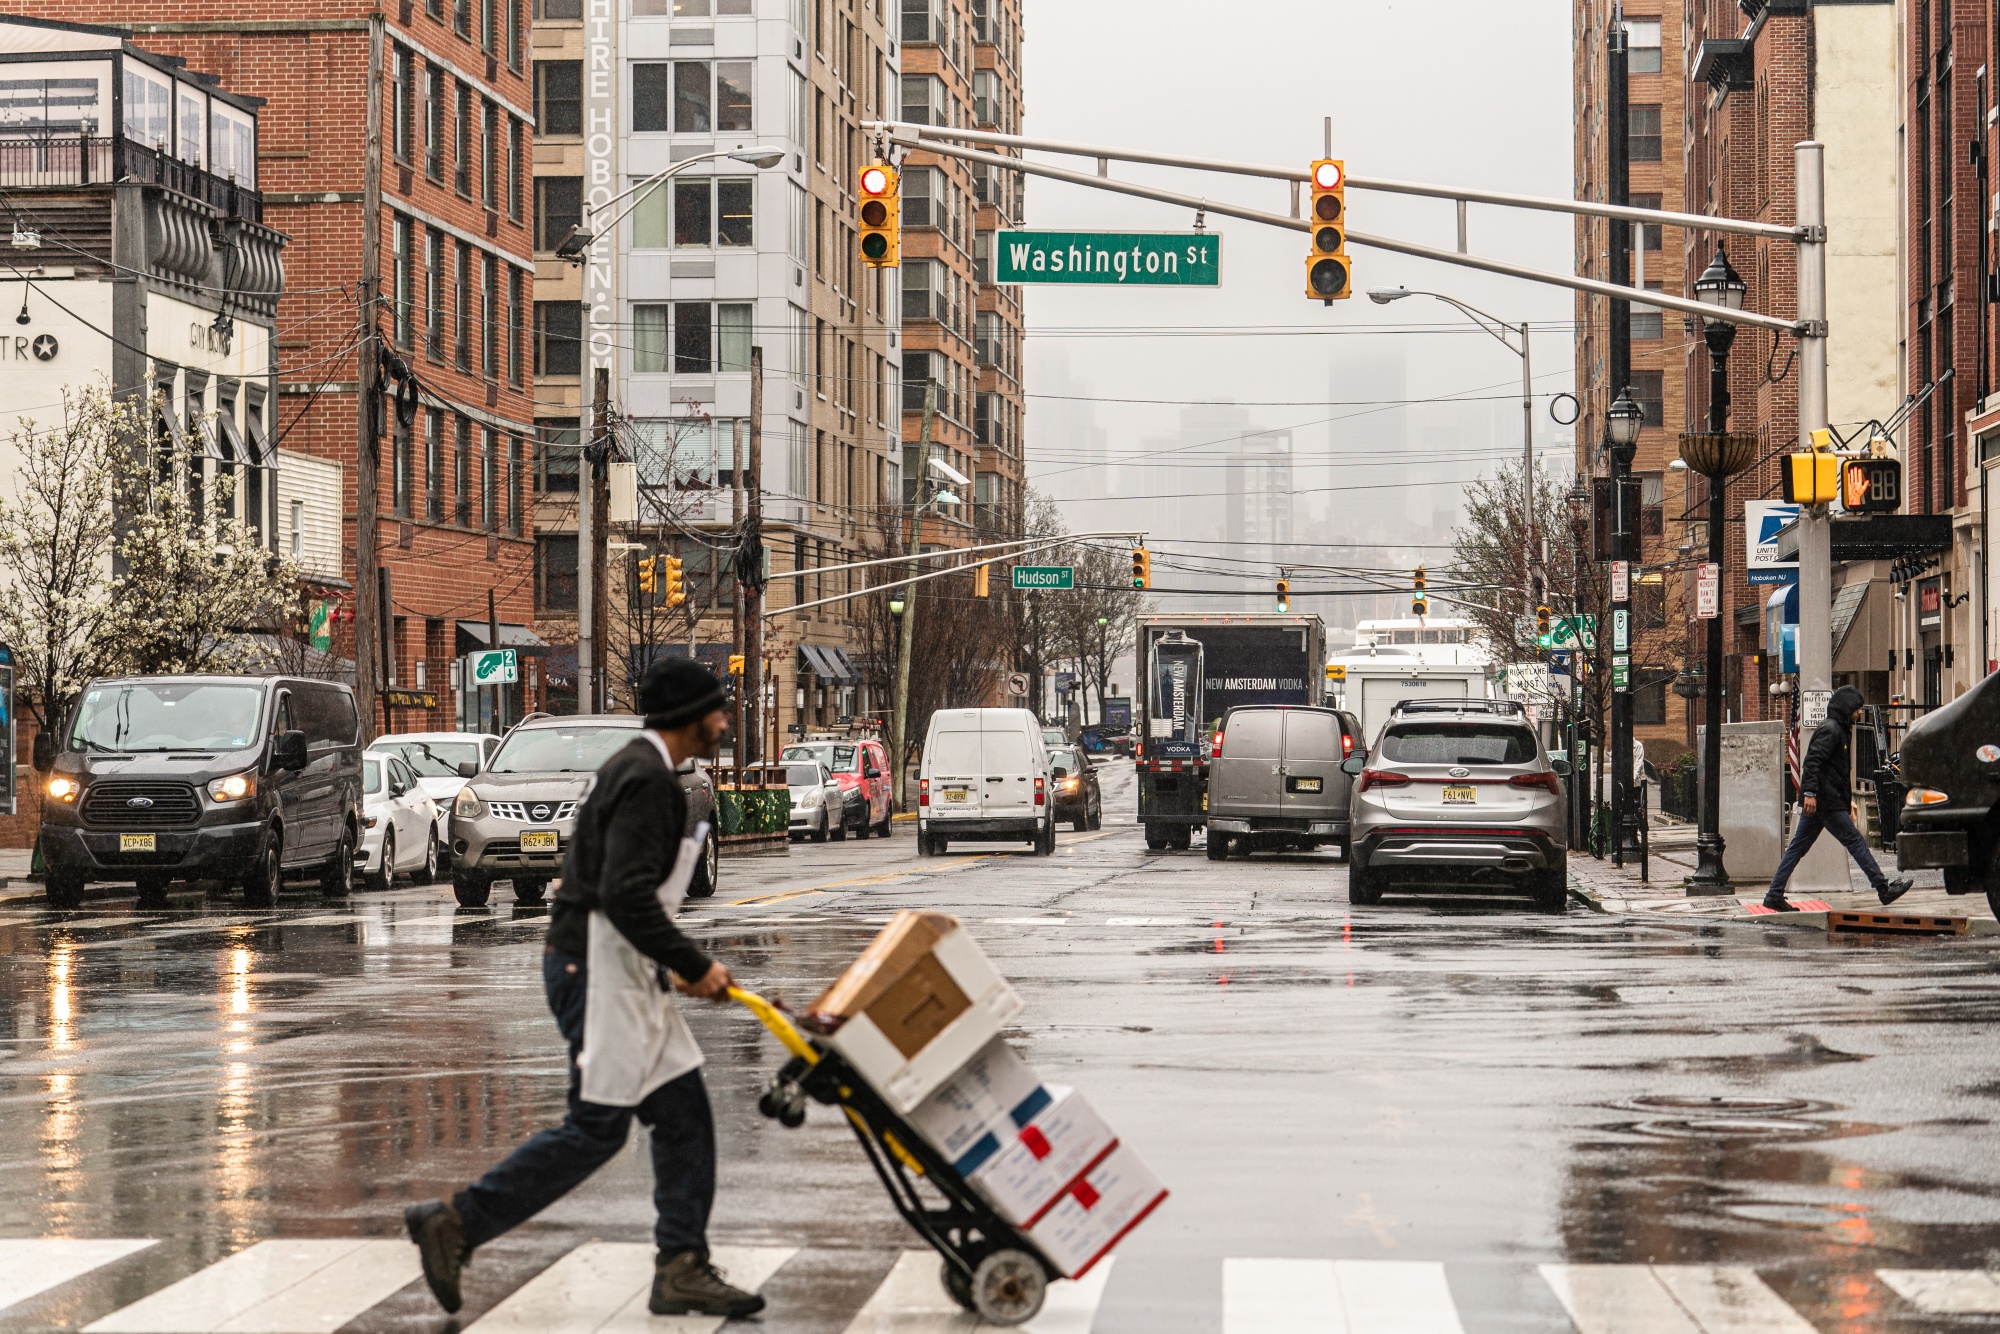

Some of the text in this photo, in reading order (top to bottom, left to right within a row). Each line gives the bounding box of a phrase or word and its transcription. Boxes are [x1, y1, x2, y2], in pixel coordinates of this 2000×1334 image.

[1010, 243, 1207, 281] Washington St
[1017, 570, 1069, 584] Hudson ST
[1699, 580, 1716, 588] MONDAY
[1618, 615, 1623, 626] P
[505, 651, 512, 664] 2
[1509, 668, 1528, 676] RIGHT
[1205, 678, 1303, 690] NEW AMSTERDAM VODKA
[1517, 679, 1539, 688] MUST
[1173, 660, 1185, 730] NEW AMSTERDAM
